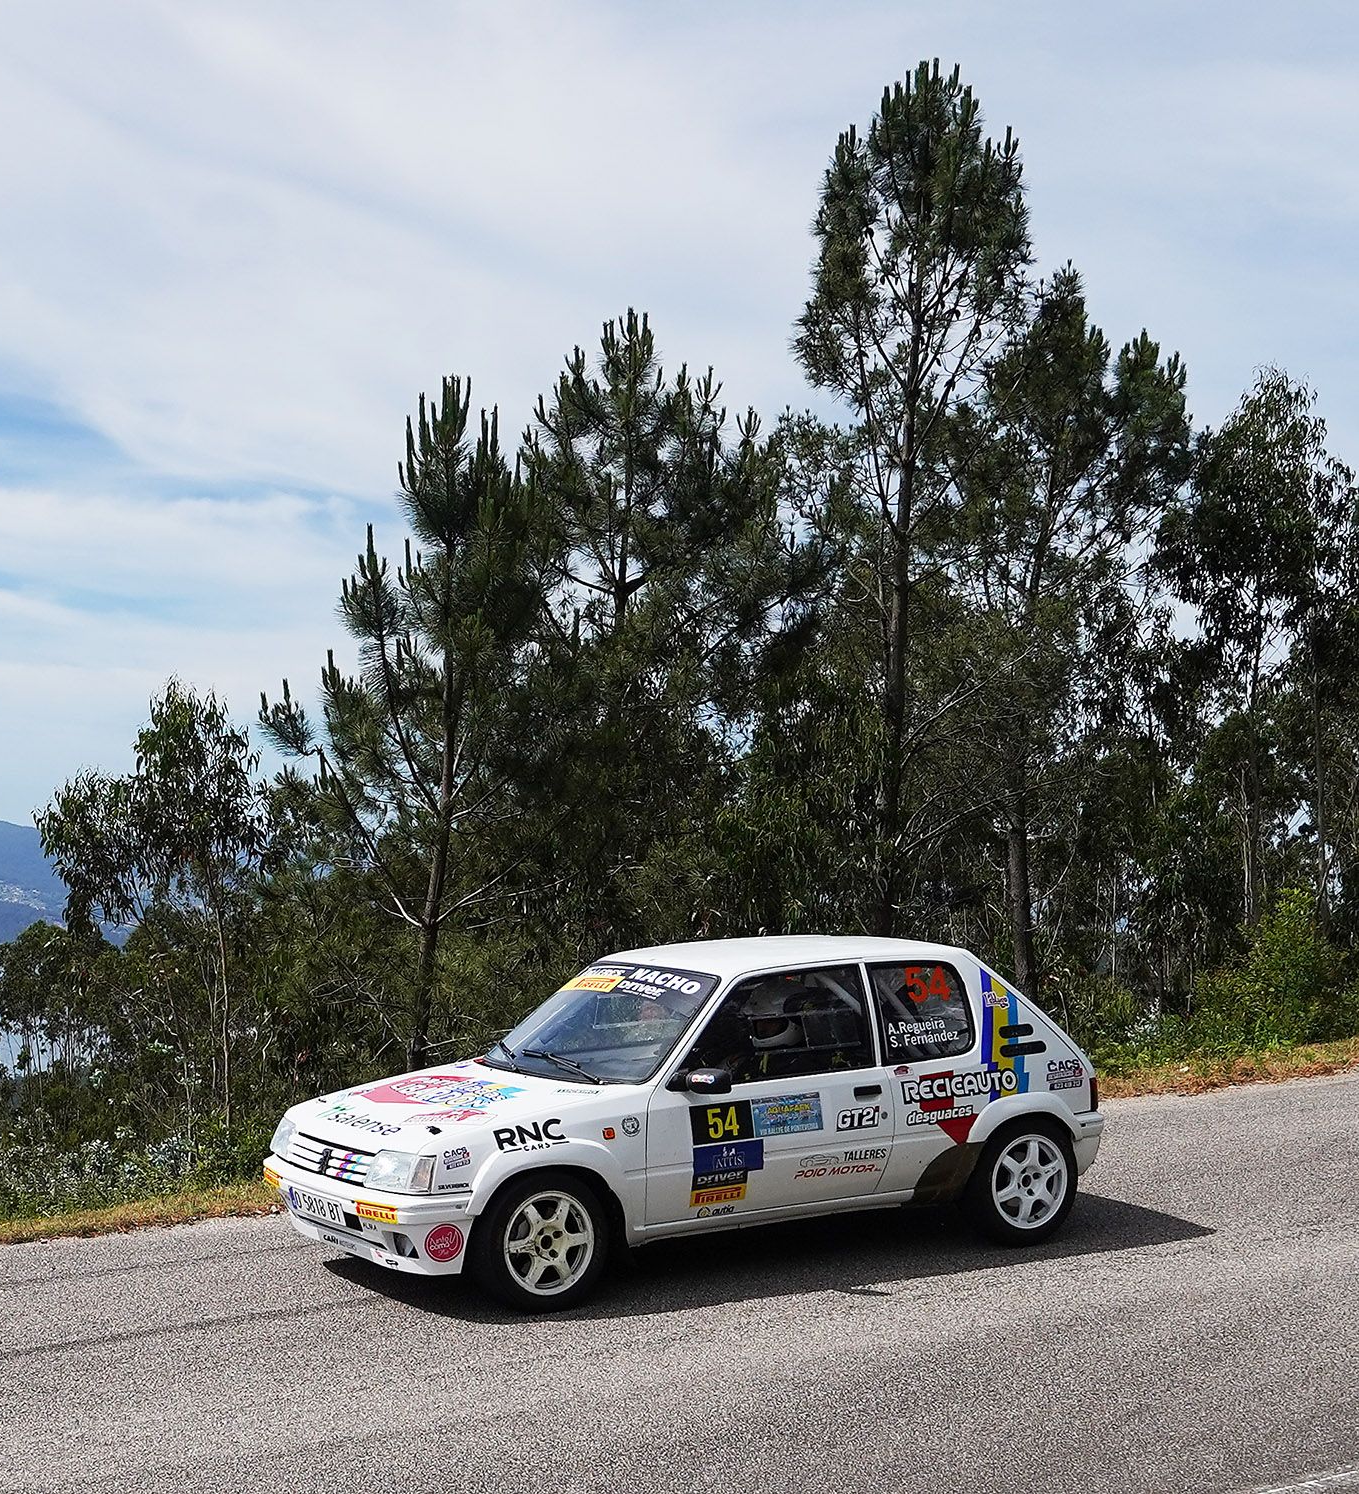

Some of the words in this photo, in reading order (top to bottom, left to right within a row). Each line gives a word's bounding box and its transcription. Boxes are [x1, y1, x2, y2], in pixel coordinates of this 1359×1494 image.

[629, 968, 701, 995] NACHO
[905, 966, 952, 1003] 54
[890, 1036, 902, 1047] S.
[904, 1030, 959, 1047] Fernández
[707, 1106, 740, 1139] 54
[837, 1106, 880, 1129] GT2i
[907, 1105, 973, 1125] desguaces
[493, 1119, 566, 1151] RNC
[524, 1142, 551, 1151] CARS
[844, 1149, 887, 1161] TALLERES
[794, 1168, 827, 1179] POIO
[828, 1164, 875, 1176] MOTOR
[694, 1187, 741, 1204] PIRELLI
[302, 1193, 326, 1217] 5818
[327, 1201, 341, 1222] BT
[356, 1202, 398, 1220] PIRELLI
